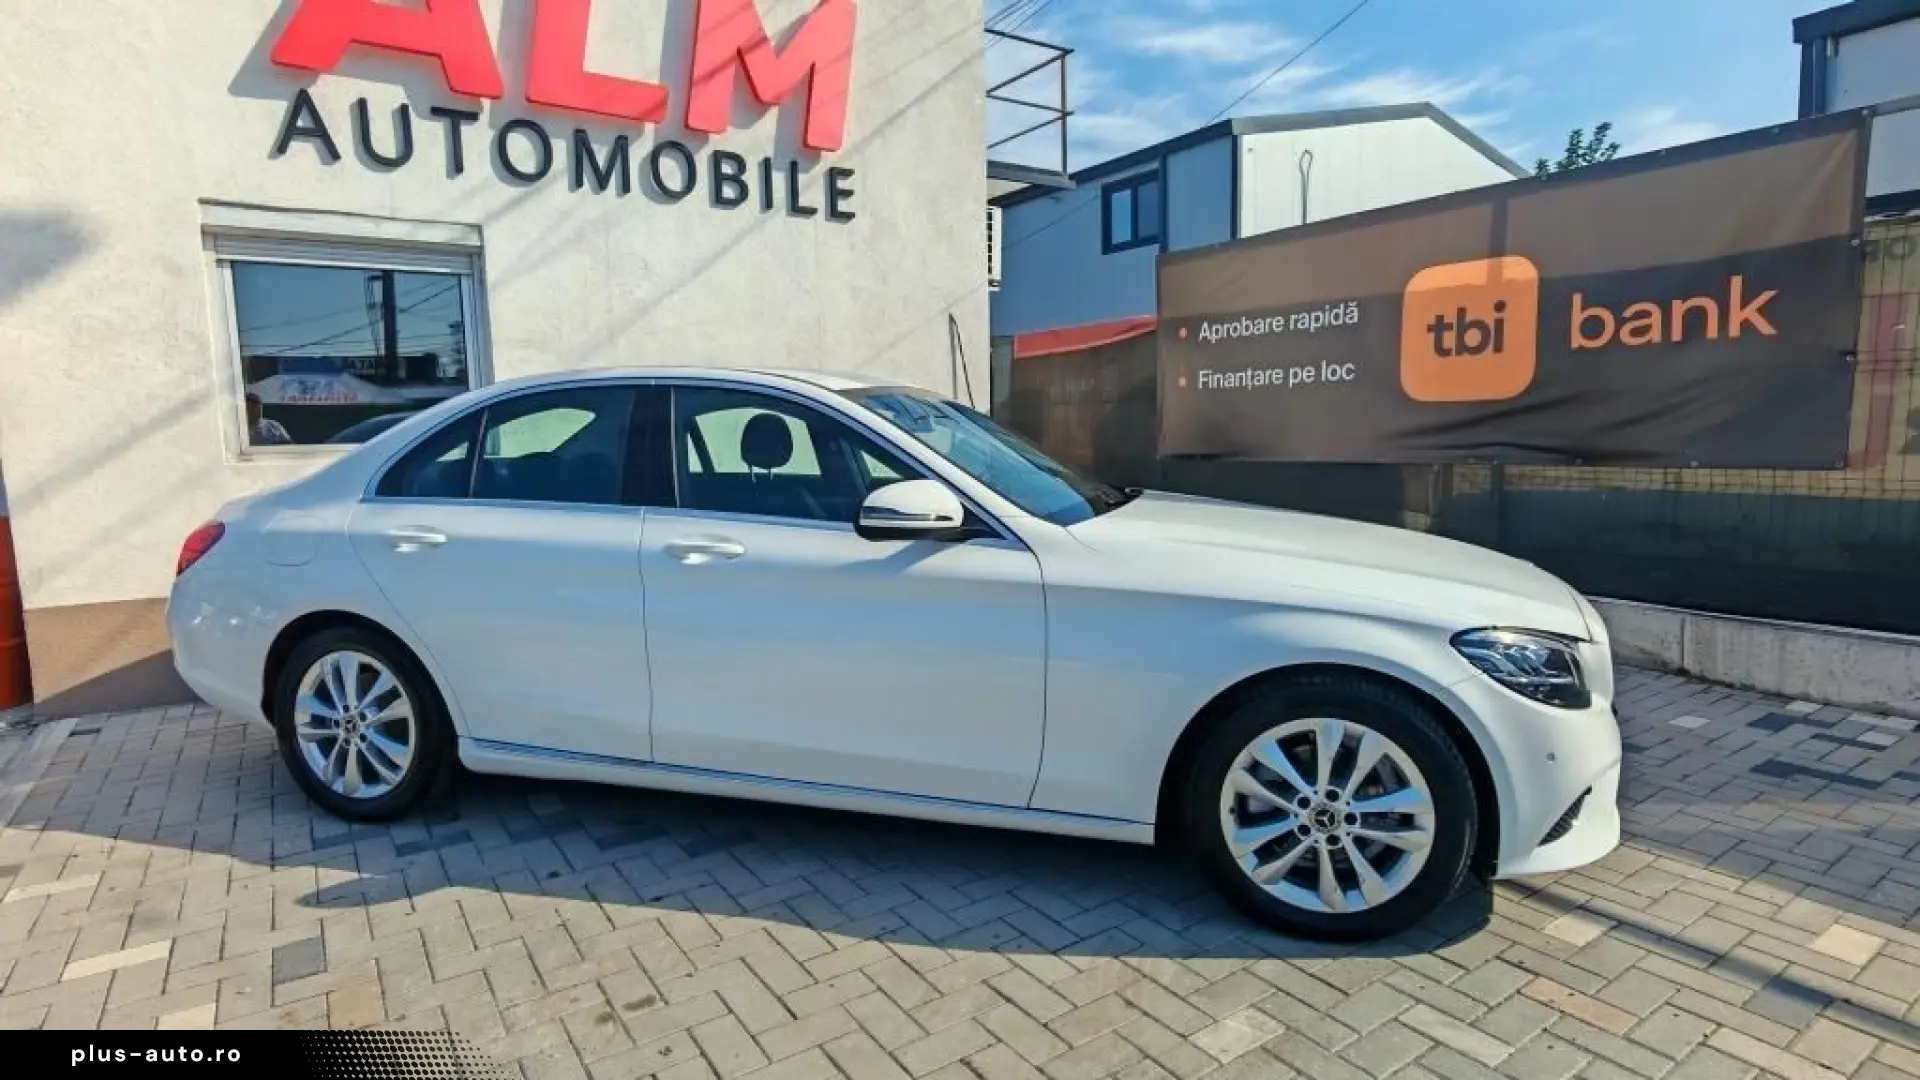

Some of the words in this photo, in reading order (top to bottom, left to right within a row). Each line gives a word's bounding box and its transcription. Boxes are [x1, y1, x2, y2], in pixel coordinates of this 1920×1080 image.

[271, 0, 857, 152] ALM
[273, 87, 856, 221] AUTOMOBILE
[1198, 316, 1284, 343] Aprobare
[1289, 301, 1360, 333] rapidă
[1427, 299, 1506, 358] tbi
[1570, 273, 1779, 351] bank
[1198, 367, 1284, 390] Finanțare
[1289, 365, 1316, 389] pe
[1321, 360, 1356, 382] loc
